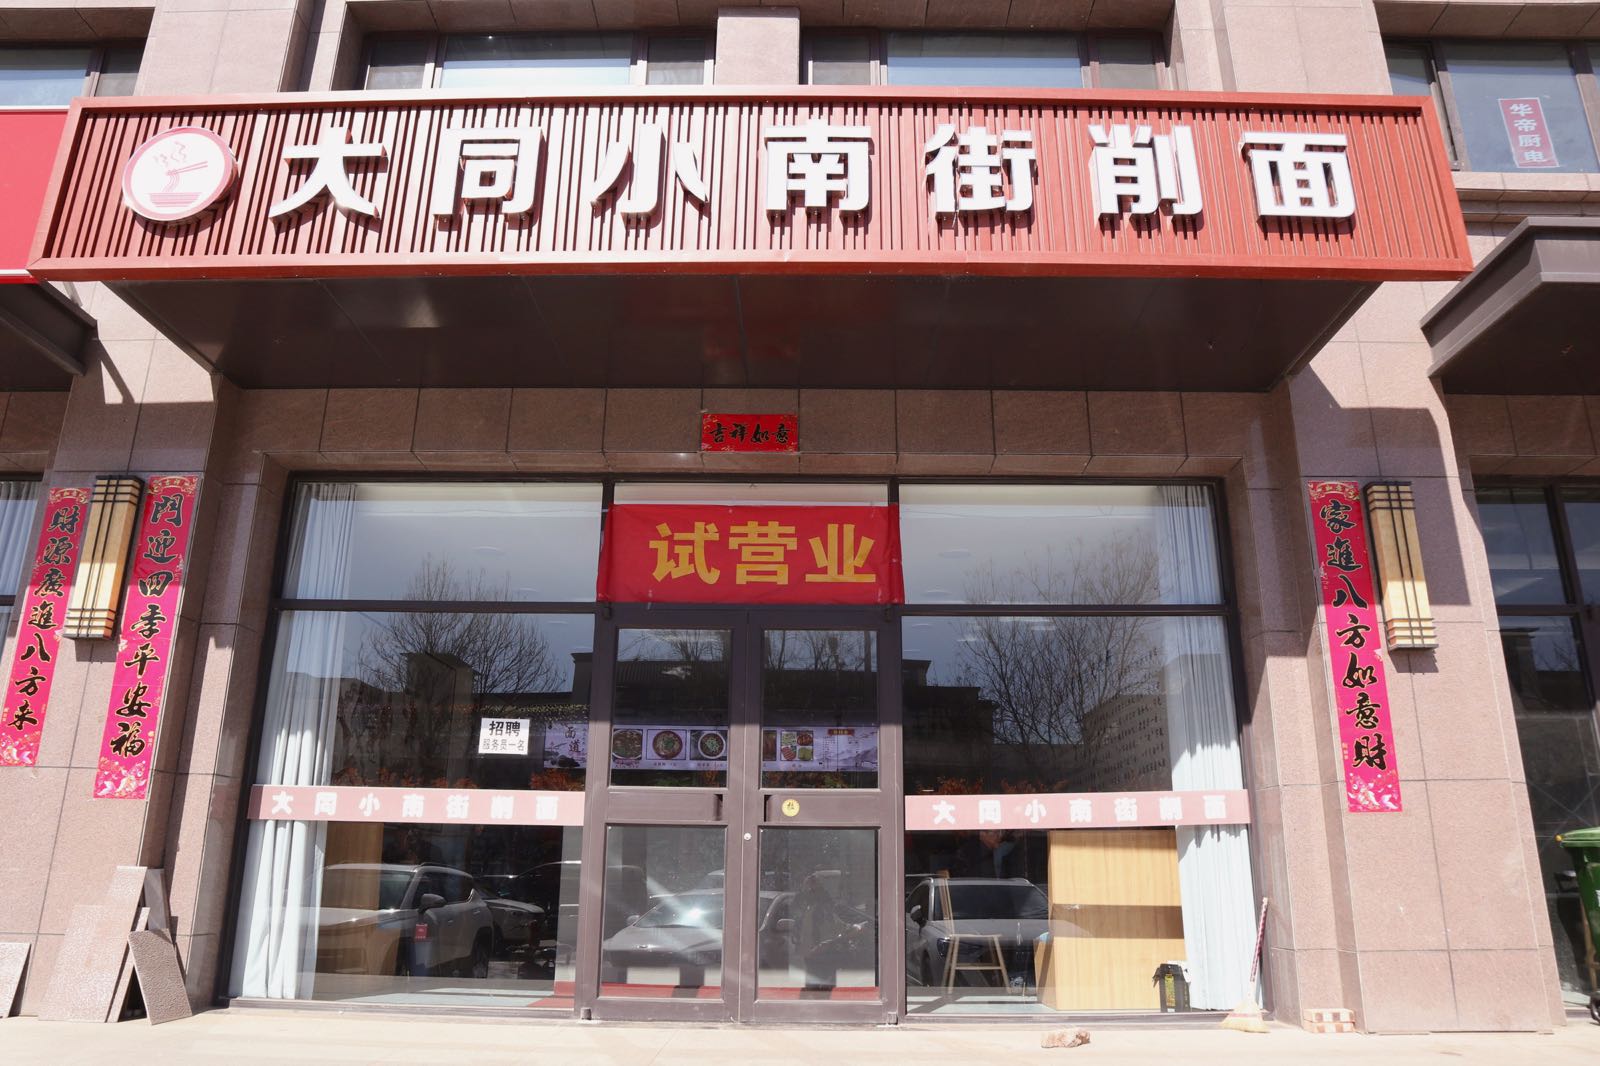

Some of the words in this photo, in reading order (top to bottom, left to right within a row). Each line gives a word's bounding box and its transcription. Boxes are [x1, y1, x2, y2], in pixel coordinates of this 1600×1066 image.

[1509, 103, 1545, 162] 华帝厨电
[269, 117, 1356, 220] 大同小南街削面
[707, 423, 791, 444] 吉祥如意
[649, 521, 876, 585] 试营业
[489, 721, 520, 737] 招聘
[482, 738, 524, 751] 服务员一名
[271, 790, 559, 820] 大同小南街削面
[932, 795, 1226, 824] 大同小南街削面
